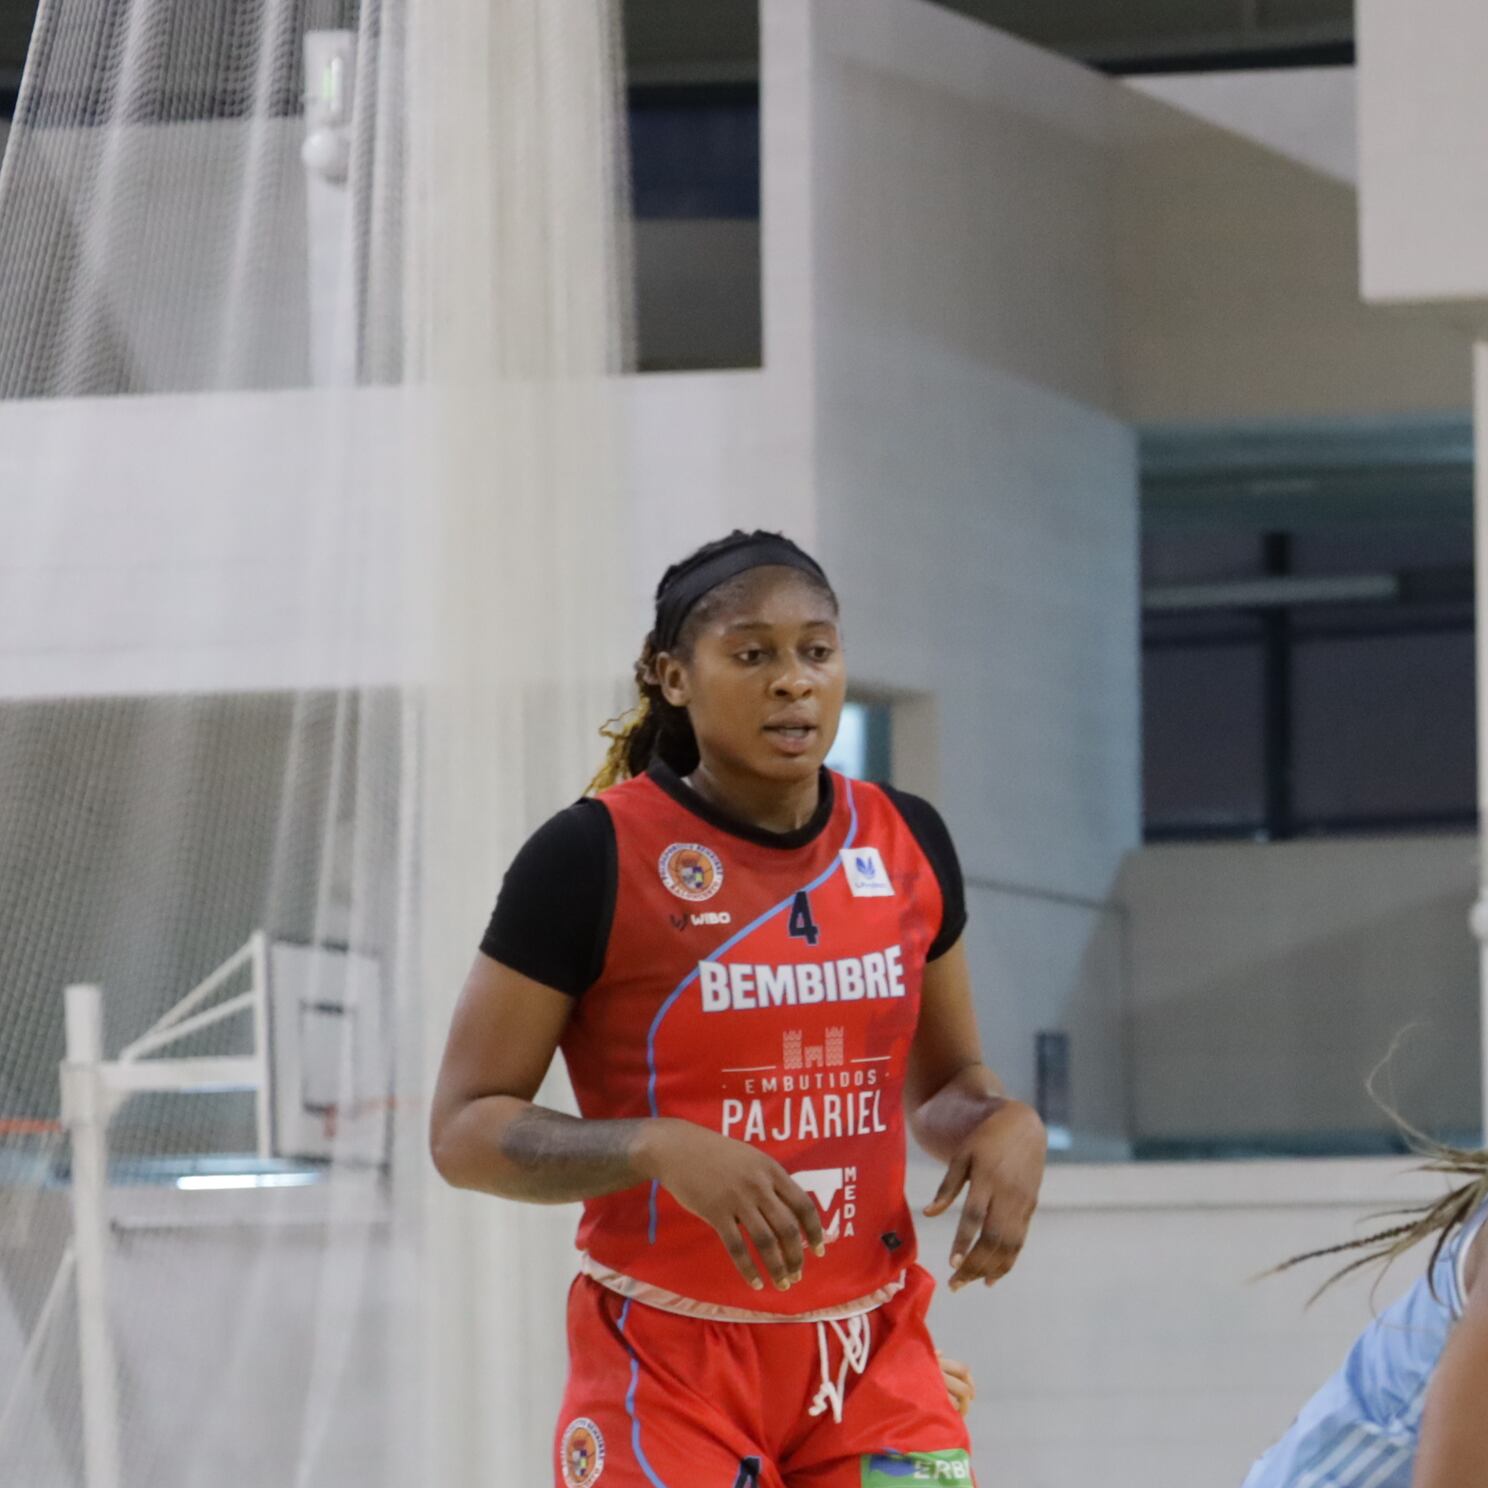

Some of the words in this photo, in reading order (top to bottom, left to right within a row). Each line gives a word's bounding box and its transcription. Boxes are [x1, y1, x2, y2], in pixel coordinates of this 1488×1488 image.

[690, 910, 732, 926] WIBO
[787, 890, 821, 946] 4
[697, 944, 906, 1013] BEMBIBRE
[744, 1068, 879, 1096] EMBUTIDOS
[720, 1089, 888, 1144] PAJARIEL
[842, 1165, 859, 1239] MEDA
